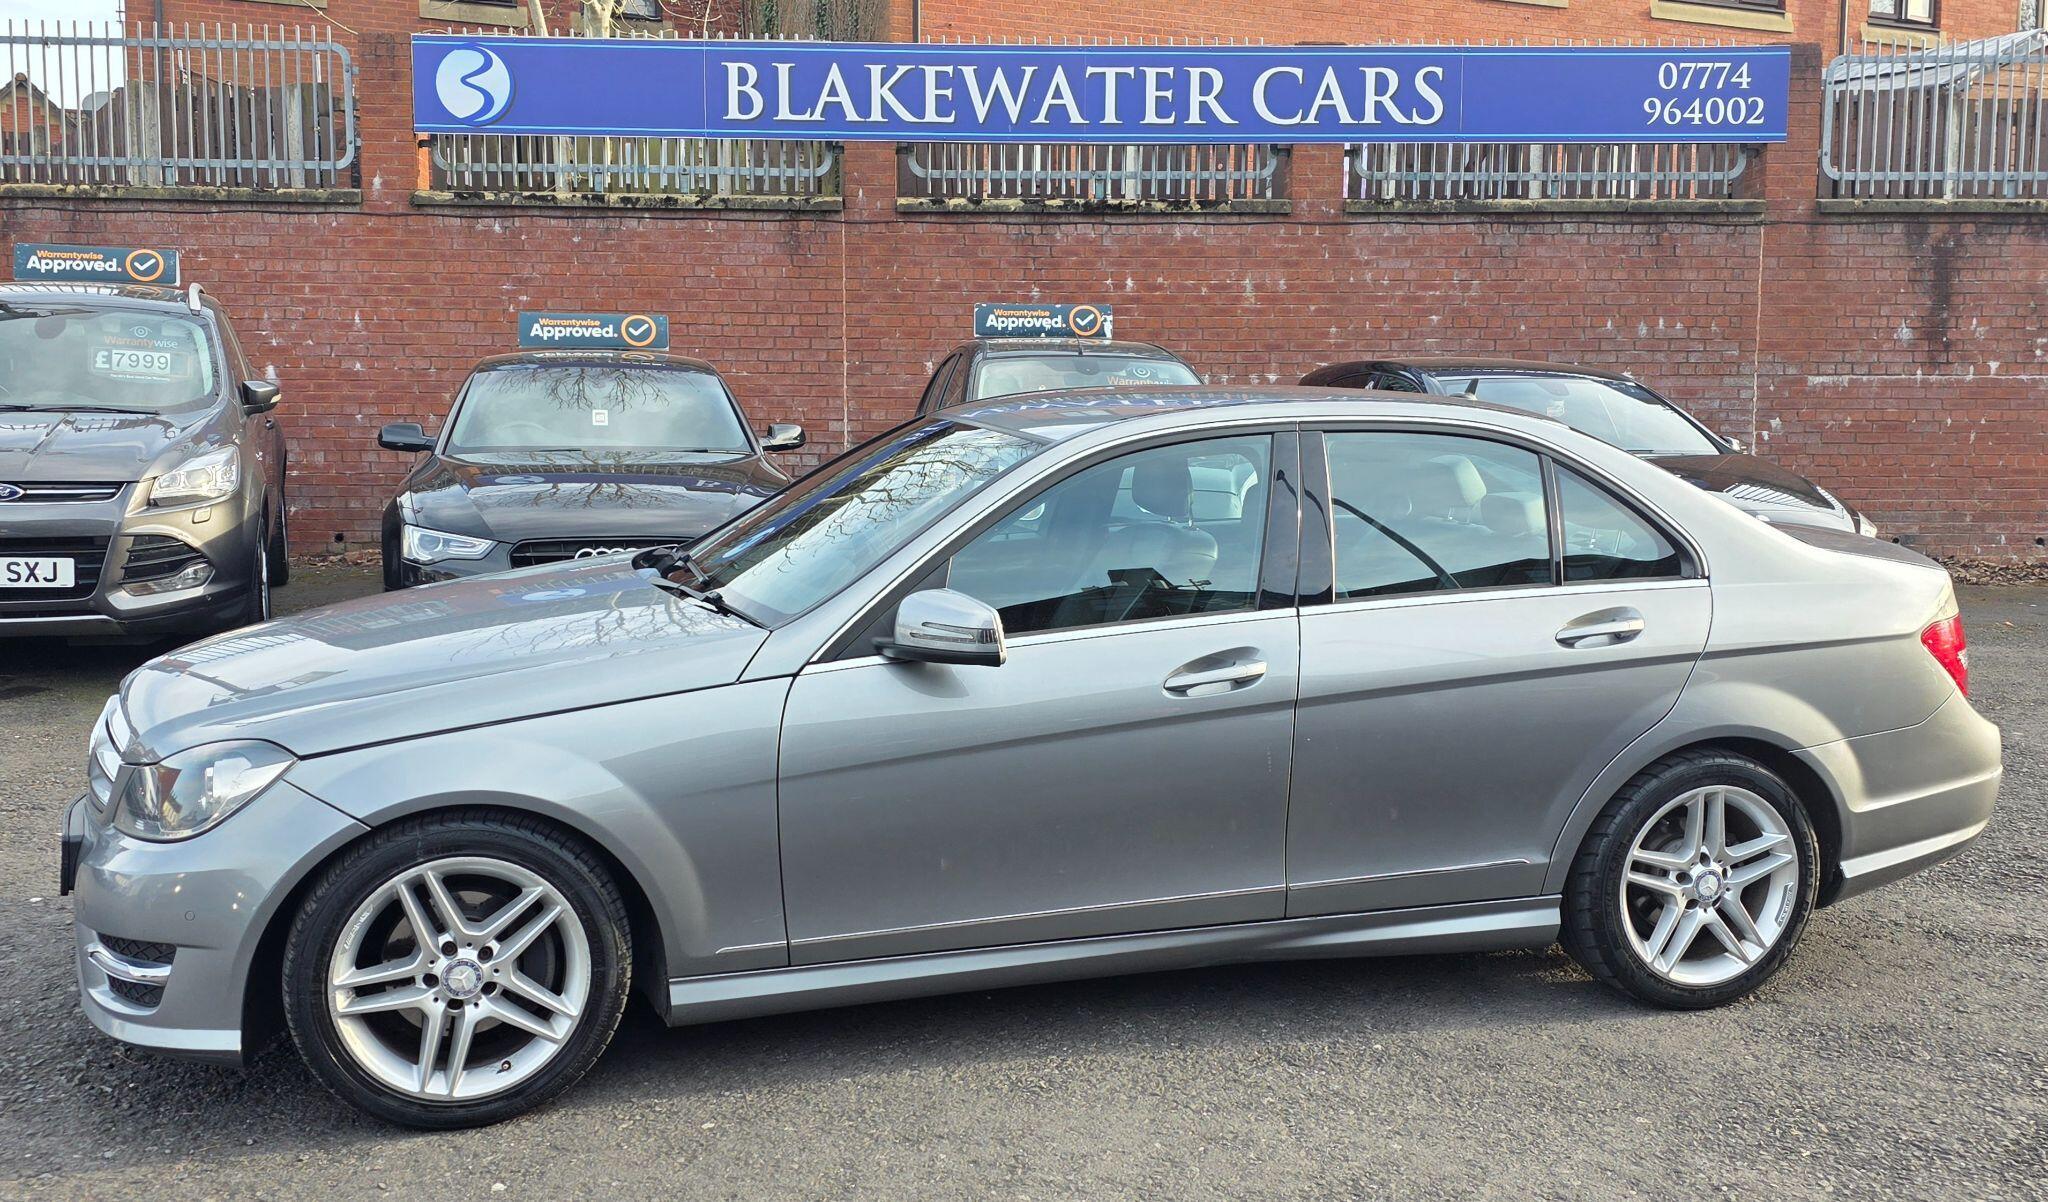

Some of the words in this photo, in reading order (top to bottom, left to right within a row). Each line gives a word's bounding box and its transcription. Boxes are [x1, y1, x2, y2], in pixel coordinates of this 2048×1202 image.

[1658, 62, 1752, 90] 07774
[721, 62, 1239, 125] BLAKEWATER
[1252, 65, 1445, 126] CARS
[1643, 97, 1765, 126] 964002
[26, 255, 123, 273] Approved.
[36, 250, 104, 260] Warrantywise
[993, 308, 1051, 318] Warrantywise
[538, 318, 601, 327] Warrantywise
[985, 314, 1067, 331] Approved.
[529, 323, 619, 341] Approved.
[103, 335, 179, 350] Warrantywise
[6, 561, 57, 583] SXJ
